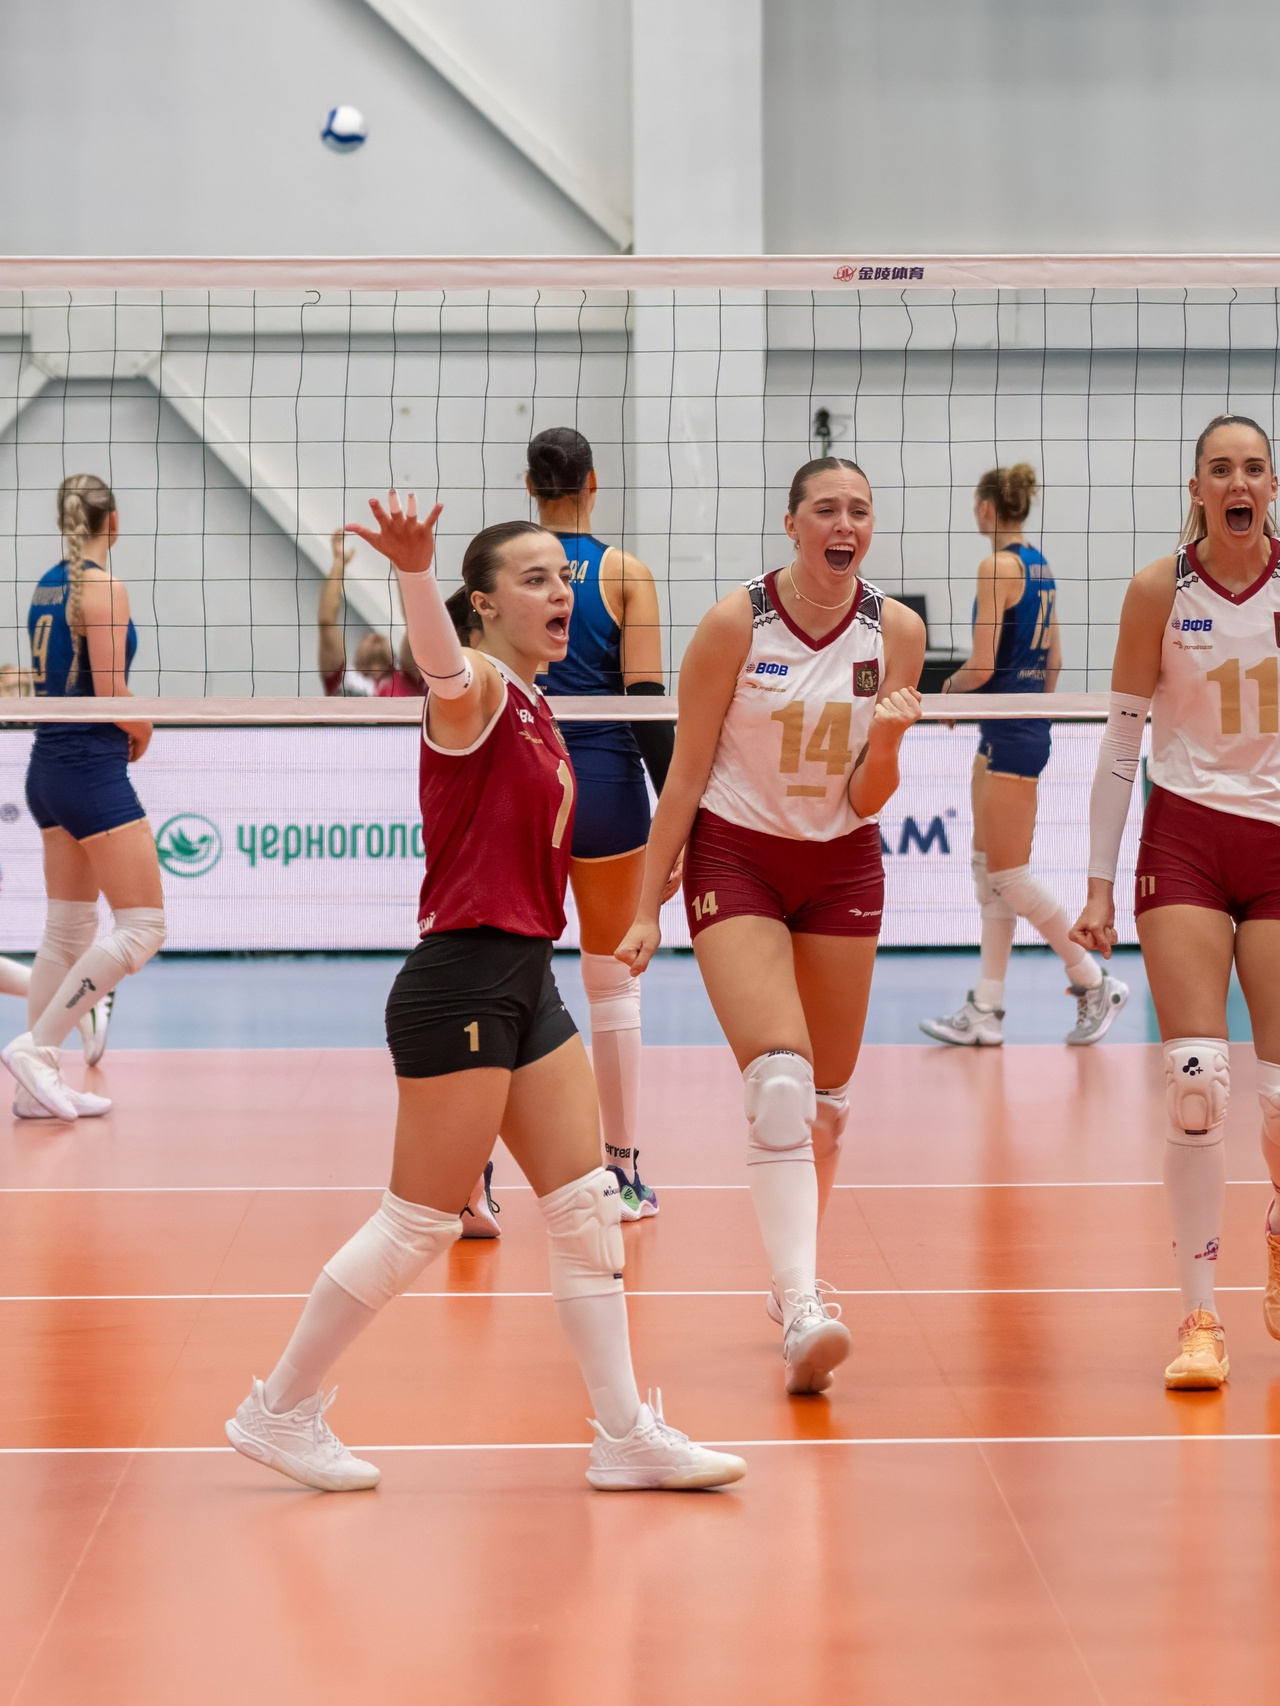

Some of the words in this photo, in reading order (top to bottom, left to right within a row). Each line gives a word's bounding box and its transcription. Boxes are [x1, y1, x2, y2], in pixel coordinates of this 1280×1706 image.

[858, 266, 925, 281] 金陵体育
[1181, 618, 1213, 632] ВФВ
[754, 662, 789, 676] ВФВ
[1206, 656, 1280, 735] 11
[770, 700, 853, 776] 14
[552, 759, 574, 850] 1
[236, 823, 426, 868] черноголо
[1140, 875, 1156, 898] 11
[691, 890, 719, 922] 14
[463, 1020, 480, 1052] 1
